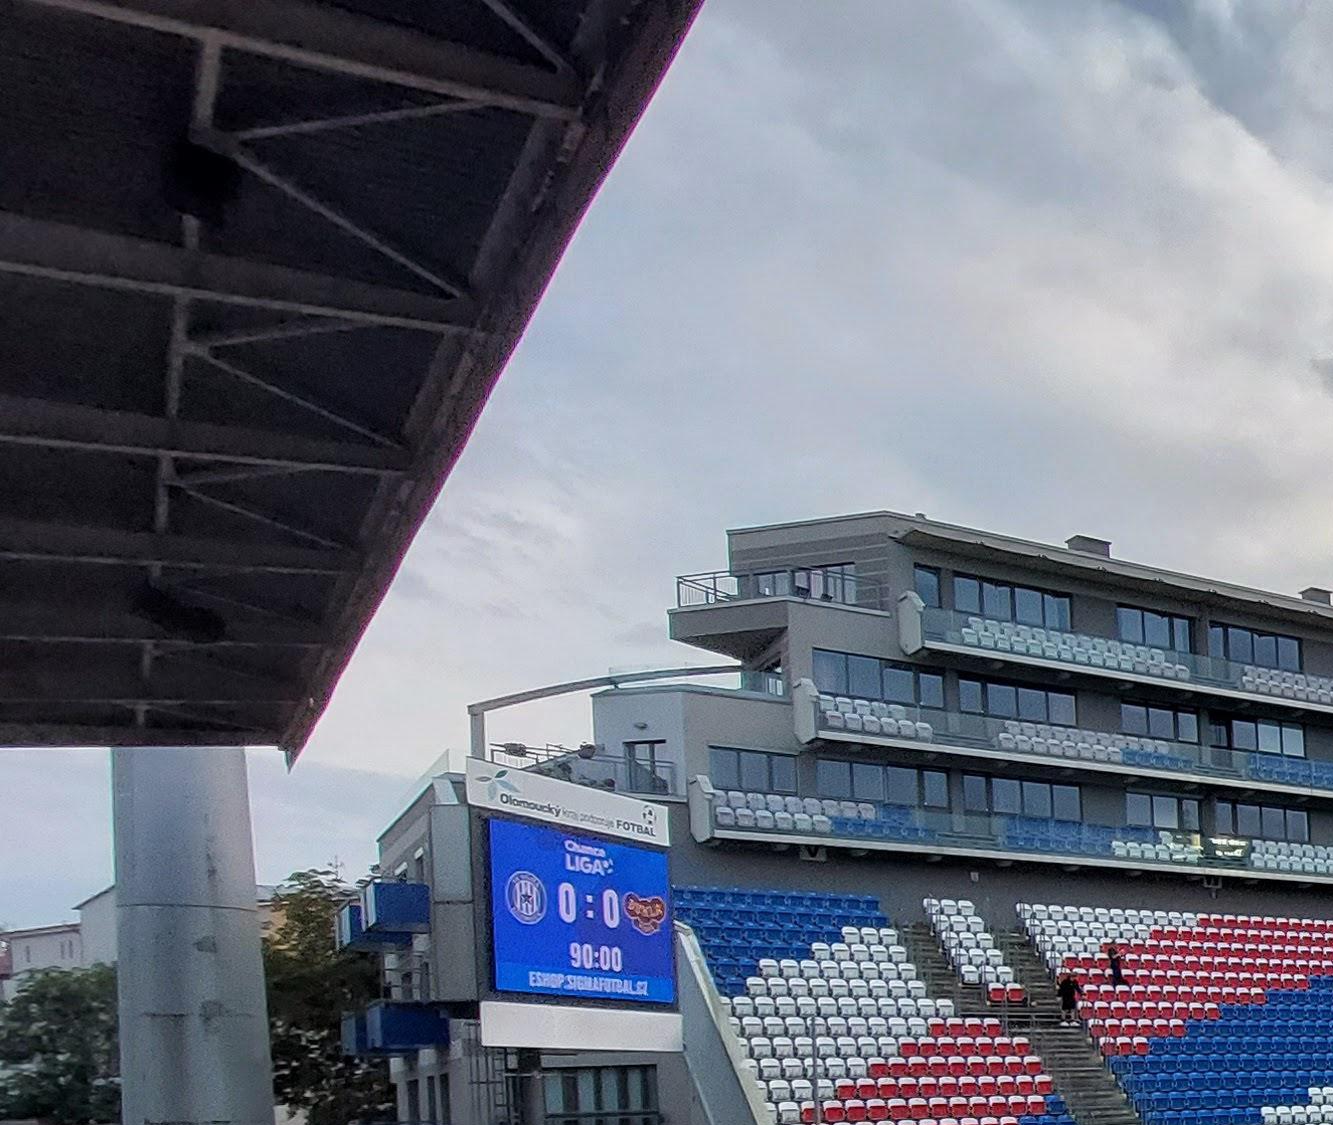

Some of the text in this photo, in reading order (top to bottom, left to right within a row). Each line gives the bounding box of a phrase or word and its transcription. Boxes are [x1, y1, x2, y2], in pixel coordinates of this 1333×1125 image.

[500, 793, 561, 818] Olomoucký
[616, 819, 656, 837] FOTBAL
[565, 853, 606, 876] LIGA
[558, 882, 576, 923] 0
[603, 889, 620, 928] 0
[569, 942, 622, 972] 90:00
